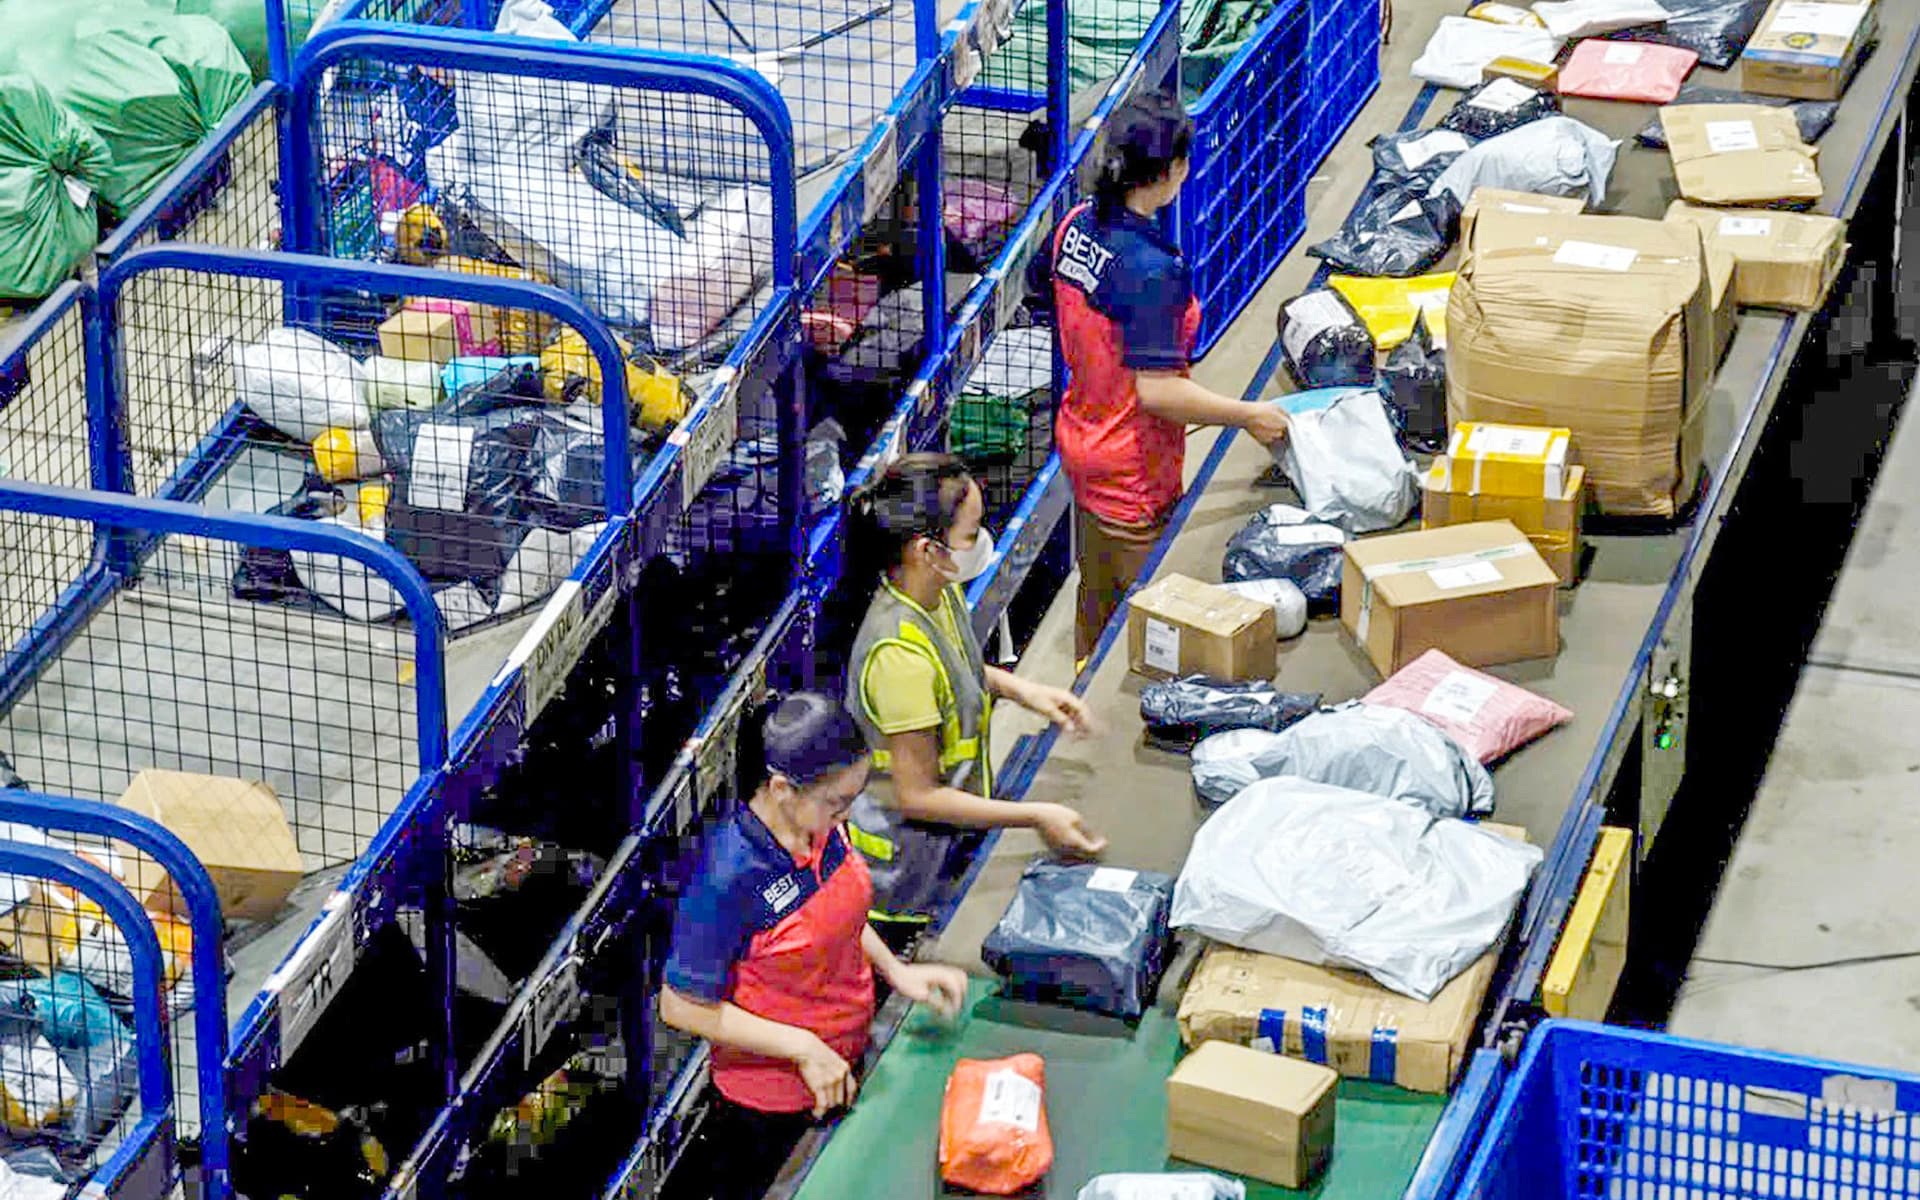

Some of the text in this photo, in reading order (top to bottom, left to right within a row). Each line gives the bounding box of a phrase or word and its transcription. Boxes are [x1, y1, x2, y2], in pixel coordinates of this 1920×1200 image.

[1062, 225, 1113, 275] BEST
[762, 873, 793, 905] BEST
[307, 958, 333, 1009] TR
